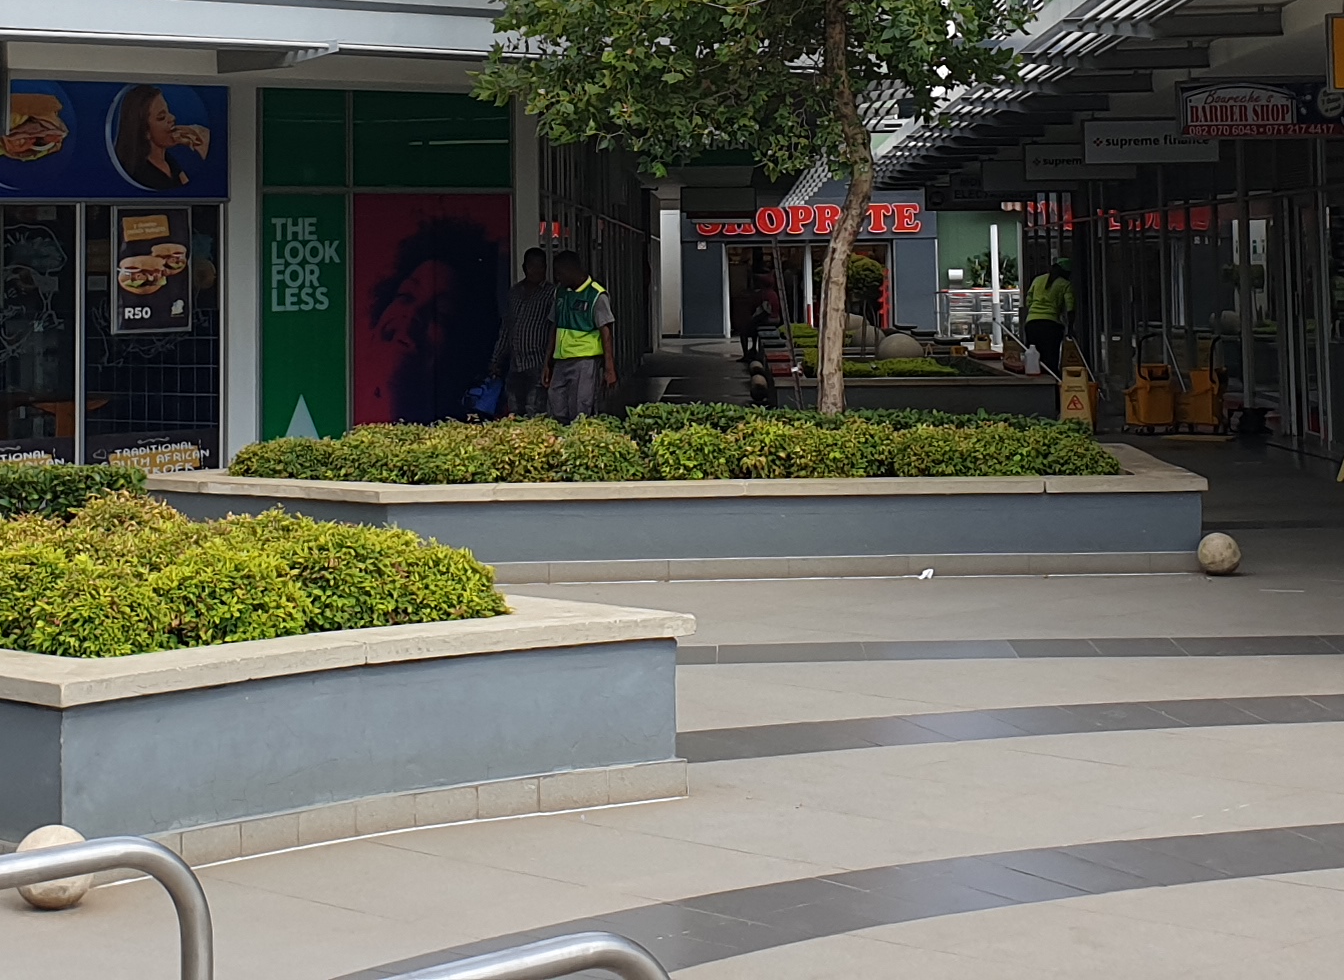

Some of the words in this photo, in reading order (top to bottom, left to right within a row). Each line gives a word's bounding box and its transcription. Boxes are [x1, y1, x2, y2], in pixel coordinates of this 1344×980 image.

[1190, 104, 1248, 123] BARBER
[1252, 103, 1289, 122] SHOP
[1189, 125, 1208, 136] 082
[1210, 125, 1229, 135] 070
[1232, 125, 1257, 135] 6043
[1266, 124, 1284, 134] 071
[1288, 124, 1307, 134] 217
[1309, 123, 1335, 134] 4417
[1105, 137, 1160, 149] supreme
[1042, 157, 1082, 167] suprem
[696, 203, 921, 235] OPRTE
[271, 217, 318, 241] THE
[271, 240, 341, 264] LOOK
[271, 264, 321, 288] FOR
[271, 286, 330, 312] LESS
[124, 307, 151, 319] R50
[114, 441, 194, 457] TRADITIONAL
[156, 448, 210, 464] AFRICAN
